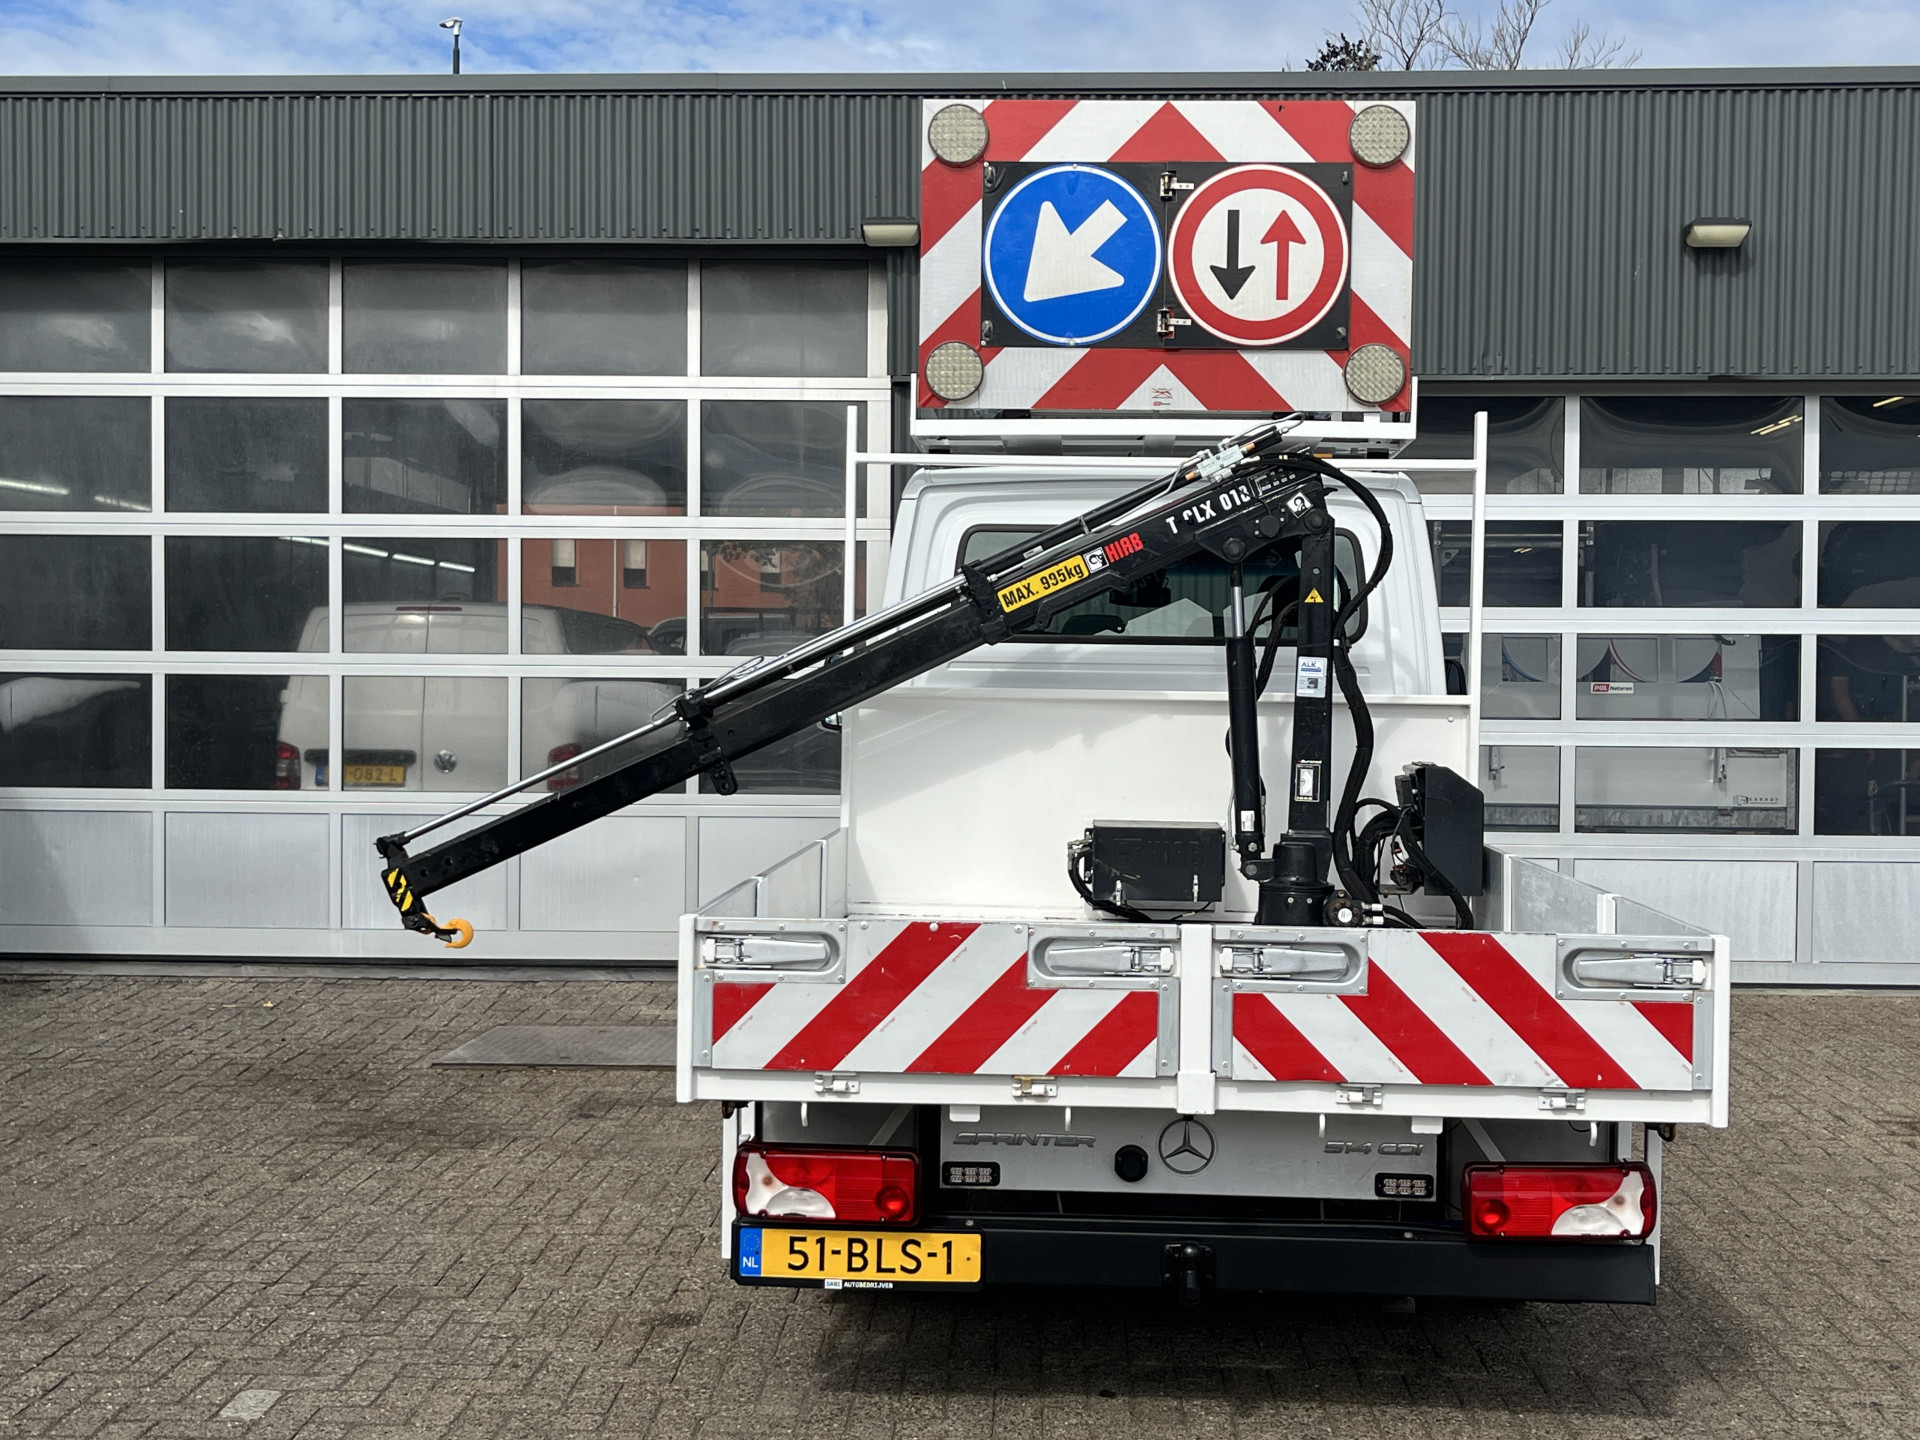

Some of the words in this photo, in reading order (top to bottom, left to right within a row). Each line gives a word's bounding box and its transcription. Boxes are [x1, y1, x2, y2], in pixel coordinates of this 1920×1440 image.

[1104, 532, 1144, 563] HIAB
[1001, 582, 1039, 608] MAX.
[953, 1131, 1097, 1149] SPRINTER
[1324, 1140, 1373, 1155] 514
[742, 1256, 759, 1269] NL
[787, 1235, 953, 1275] 51-BLS-1
